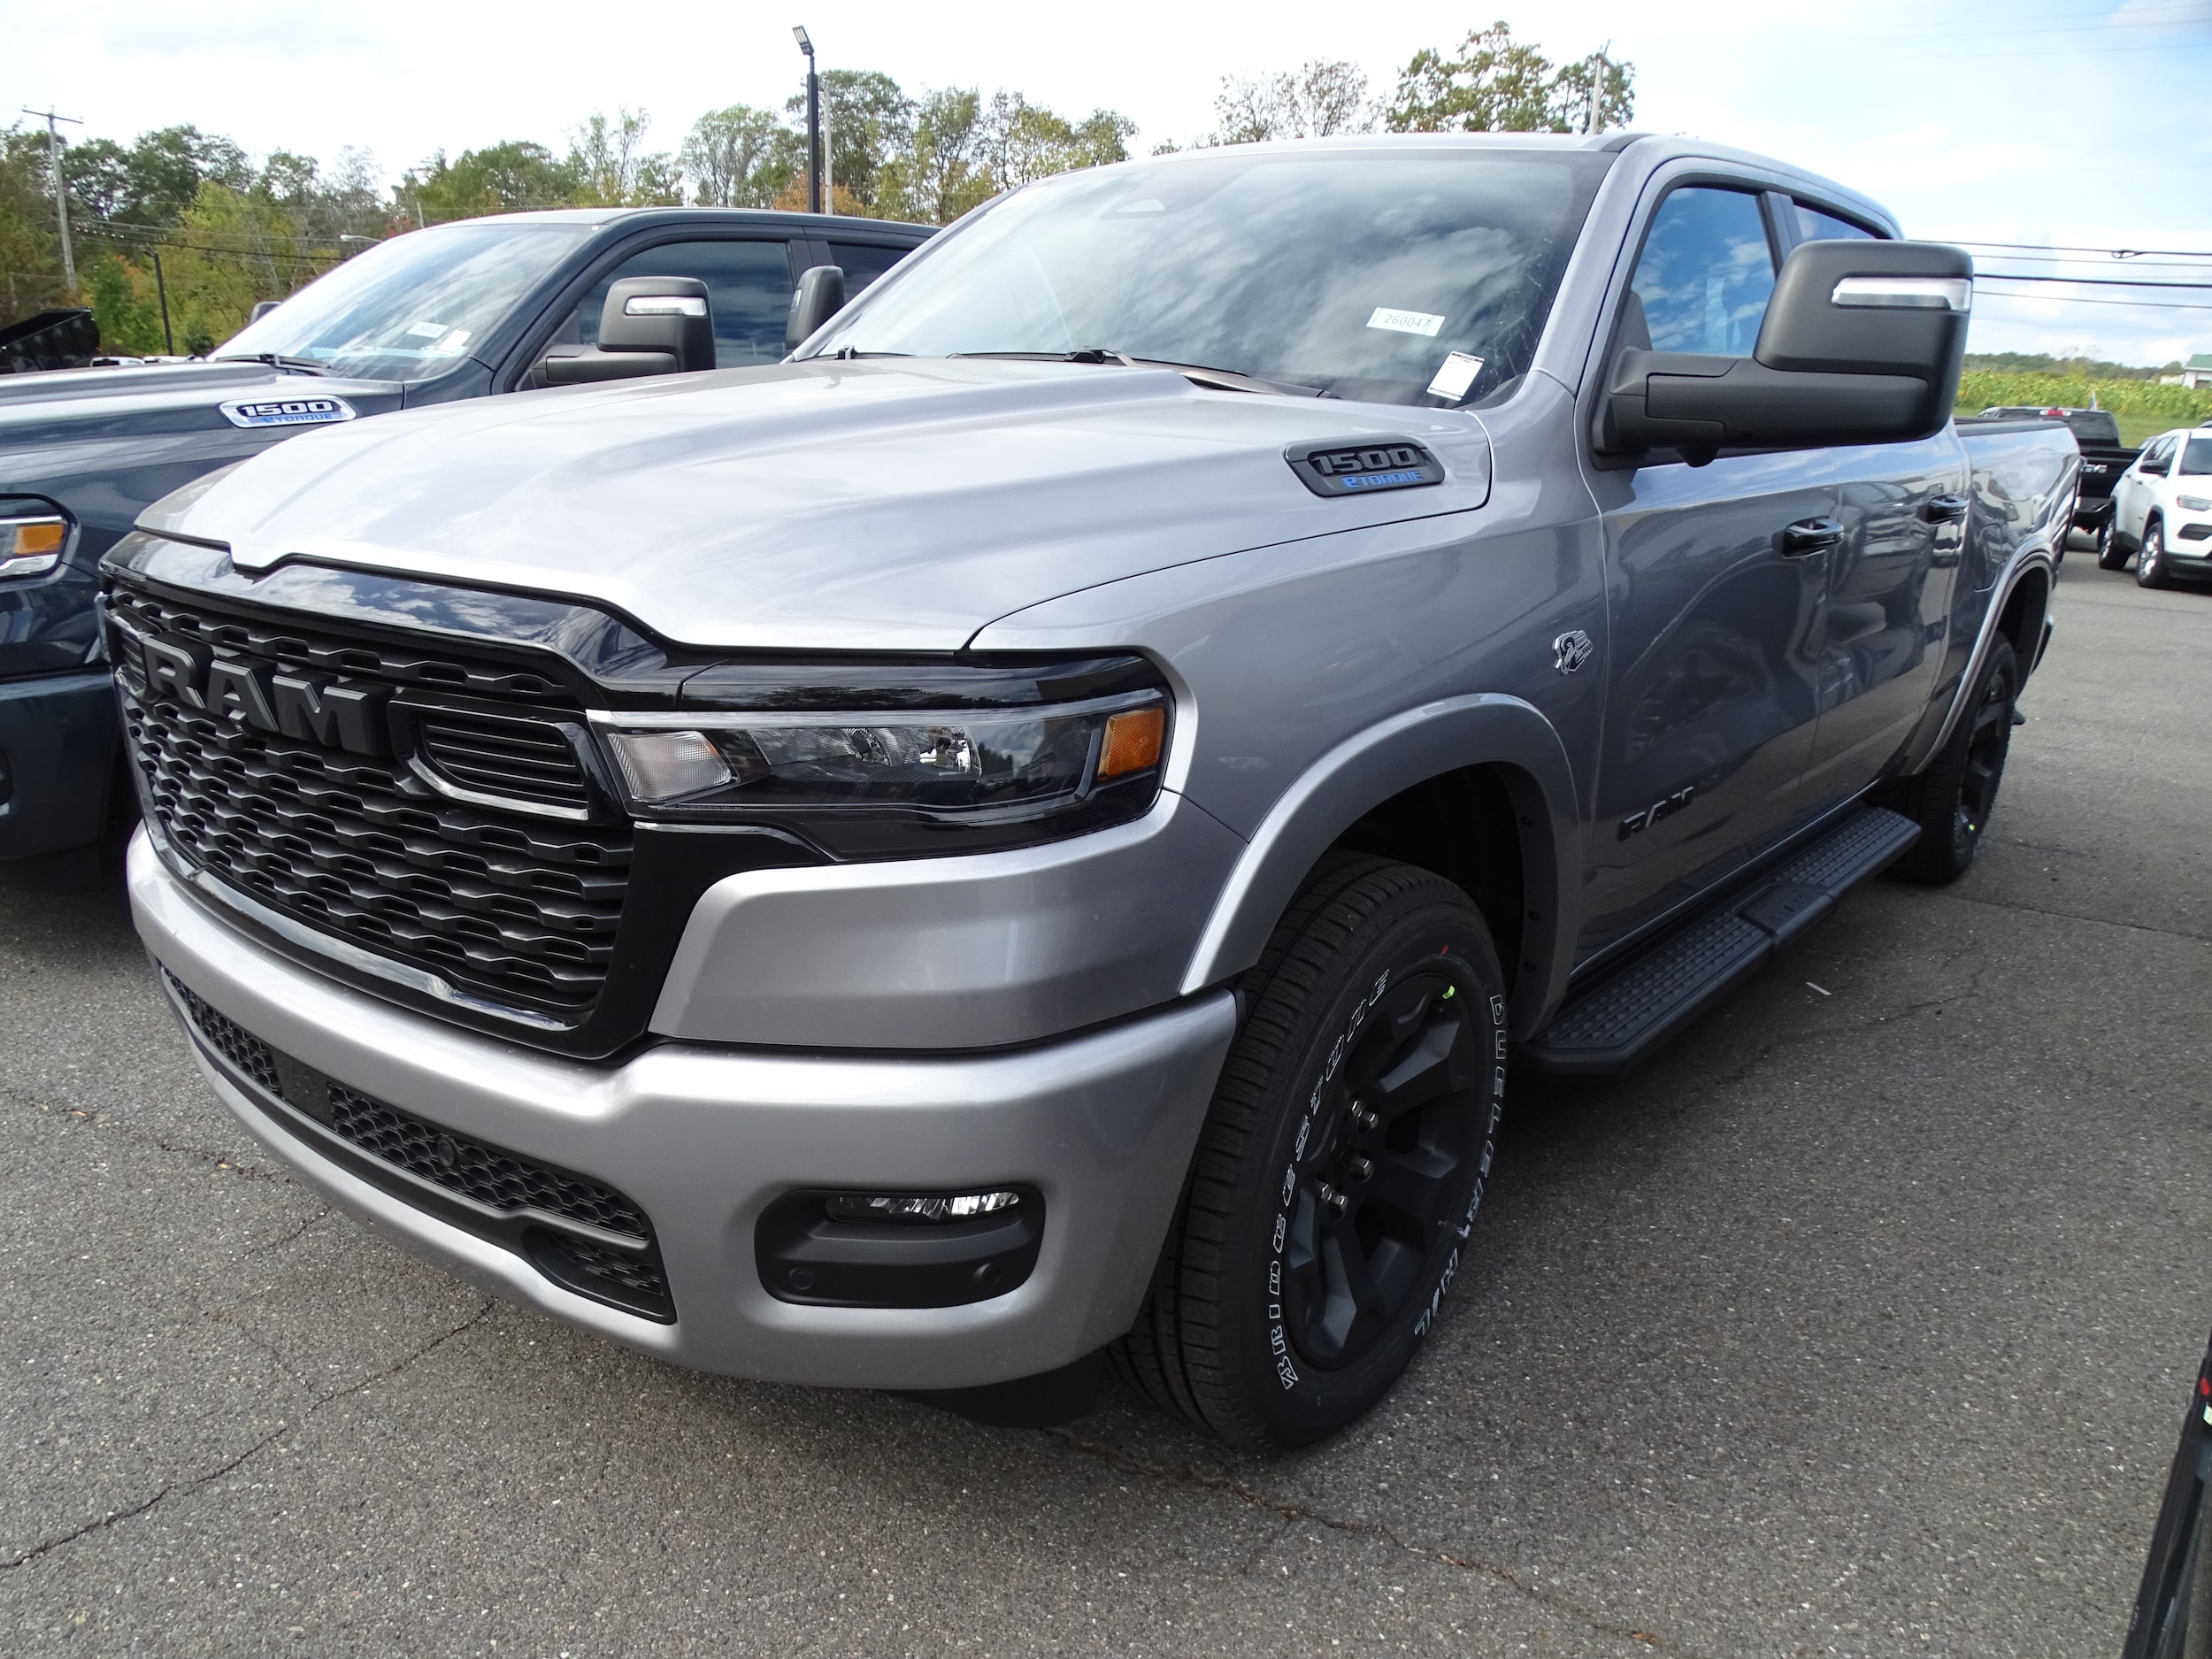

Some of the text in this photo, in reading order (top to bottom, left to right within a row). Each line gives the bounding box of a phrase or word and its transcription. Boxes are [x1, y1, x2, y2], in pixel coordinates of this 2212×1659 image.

[1384, 313, 1432, 328] 260047
[242, 401, 333, 416] 1500
[1310, 447, 1416, 474] 1500
[1341, 469, 1424, 488] eTORQUE
[143, 633, 372, 756] RAM
[1269, 969, 1390, 1389] BRIDGESTONE
